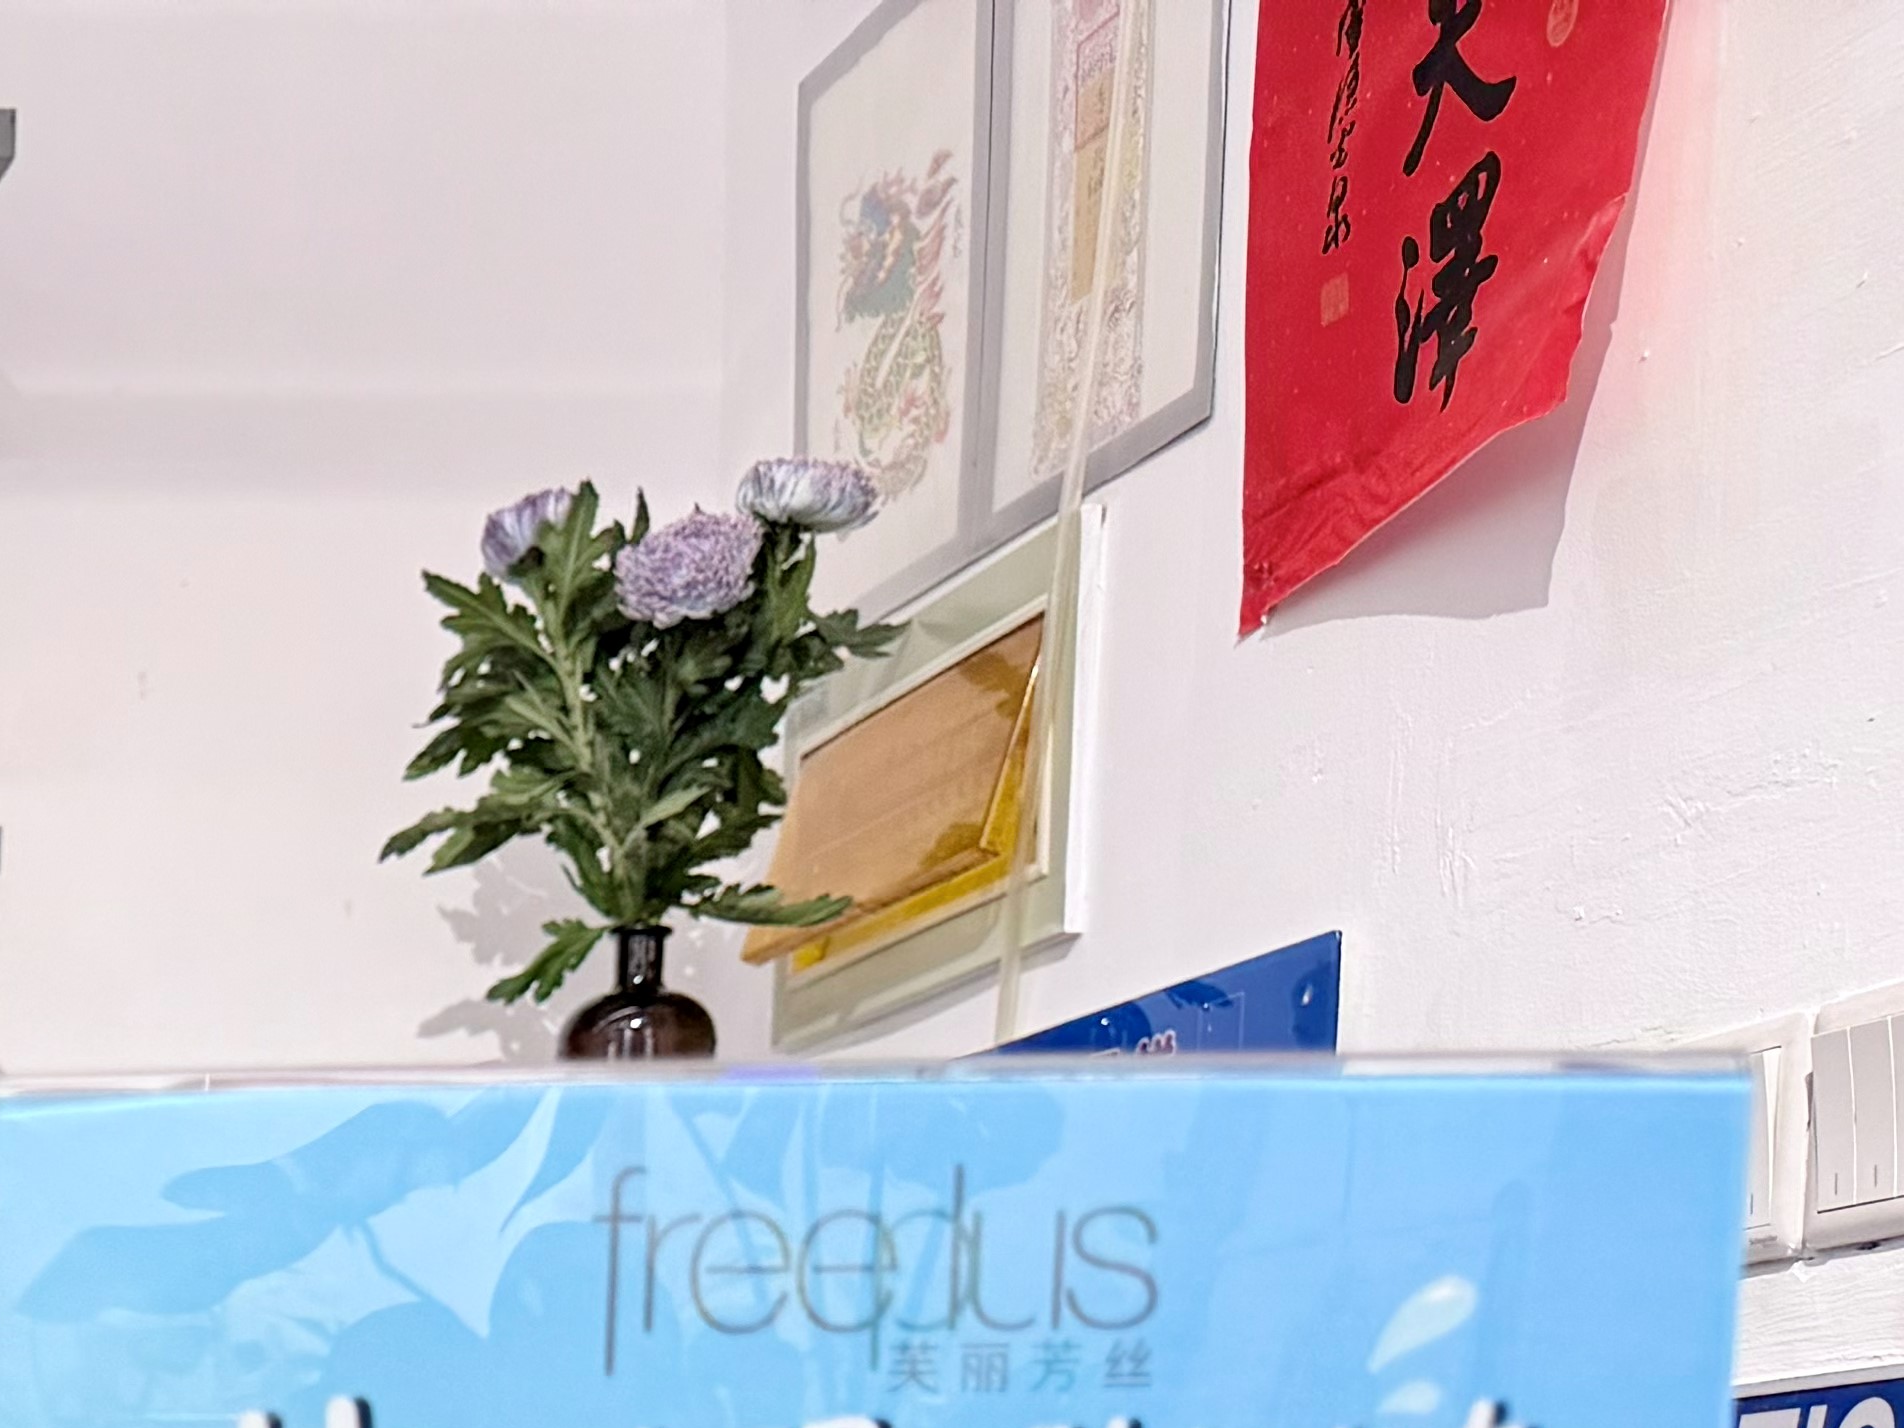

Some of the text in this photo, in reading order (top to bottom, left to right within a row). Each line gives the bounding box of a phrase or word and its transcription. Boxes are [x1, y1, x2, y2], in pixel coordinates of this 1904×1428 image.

[592, 1164, 1159, 1376] freeplus
[887, 1338, 1154, 1395] 芙丽芳丝
